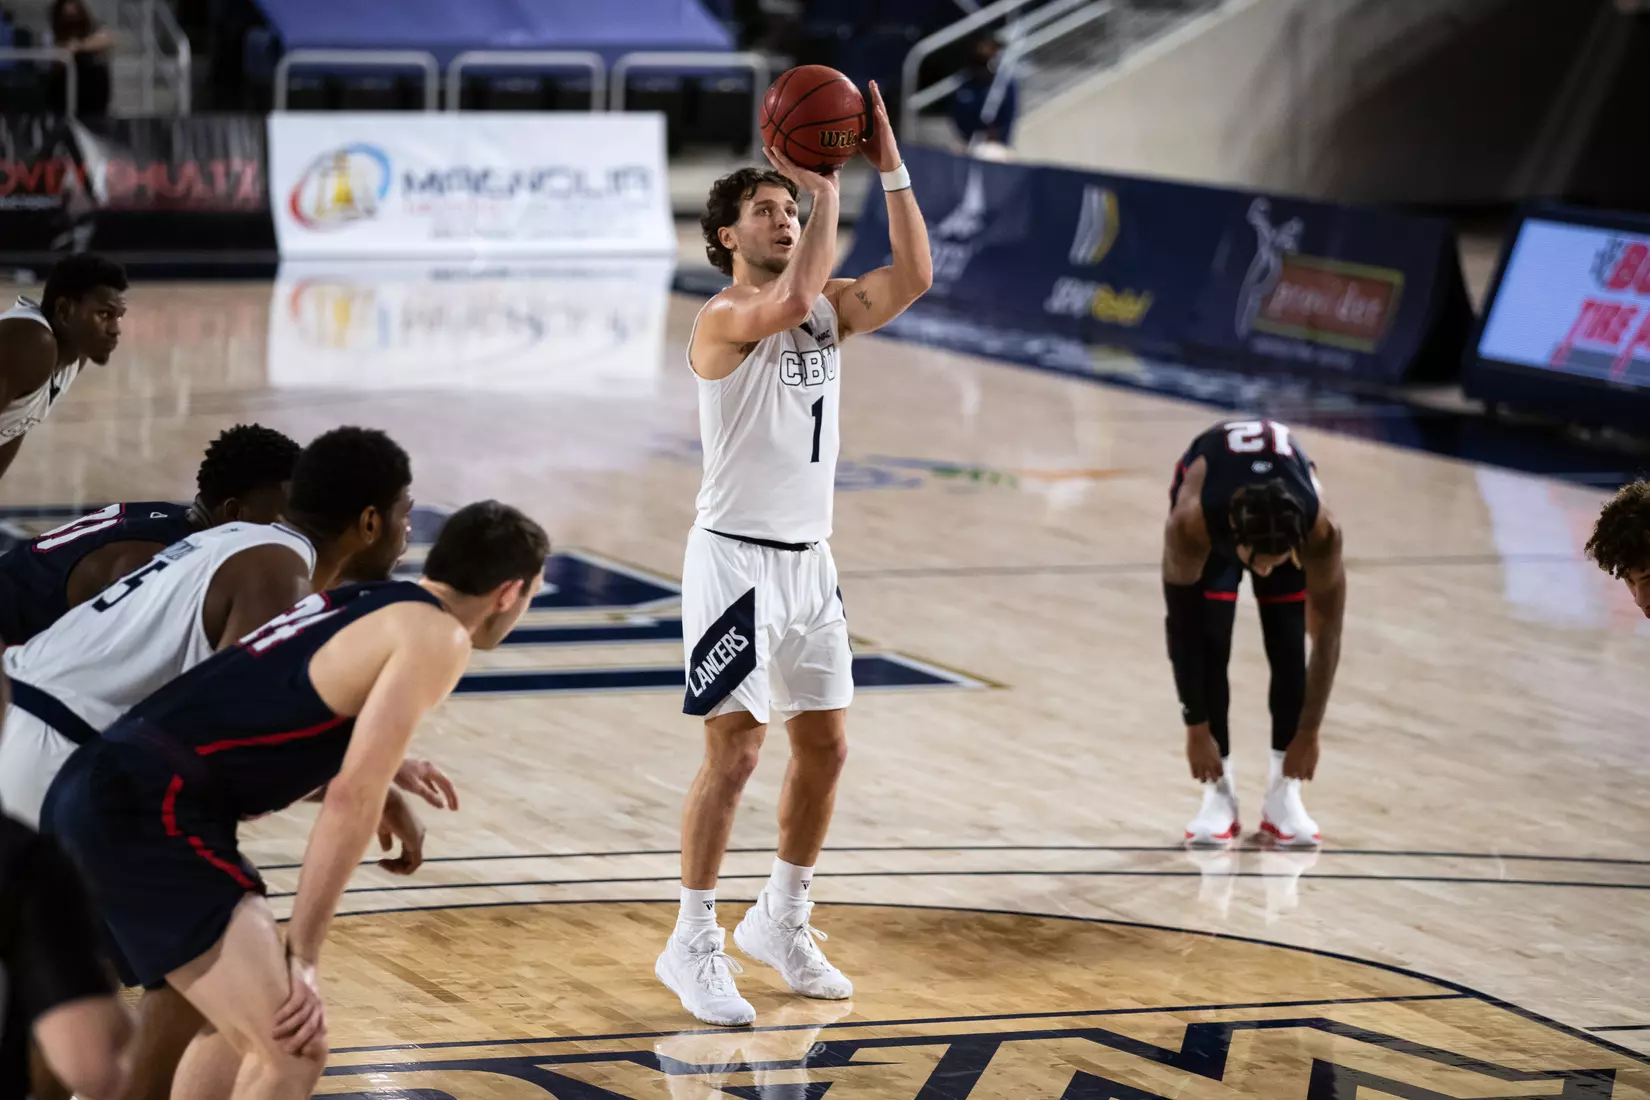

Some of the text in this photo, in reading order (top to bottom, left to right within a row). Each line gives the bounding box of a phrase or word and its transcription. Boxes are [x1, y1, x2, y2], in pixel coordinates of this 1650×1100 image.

[780, 342, 836, 387] CBU
[810, 395, 825, 463] 1
[1223, 420, 1293, 457] 12
[91, 559, 169, 613] 5
[689, 626, 750, 698] LANCERS
